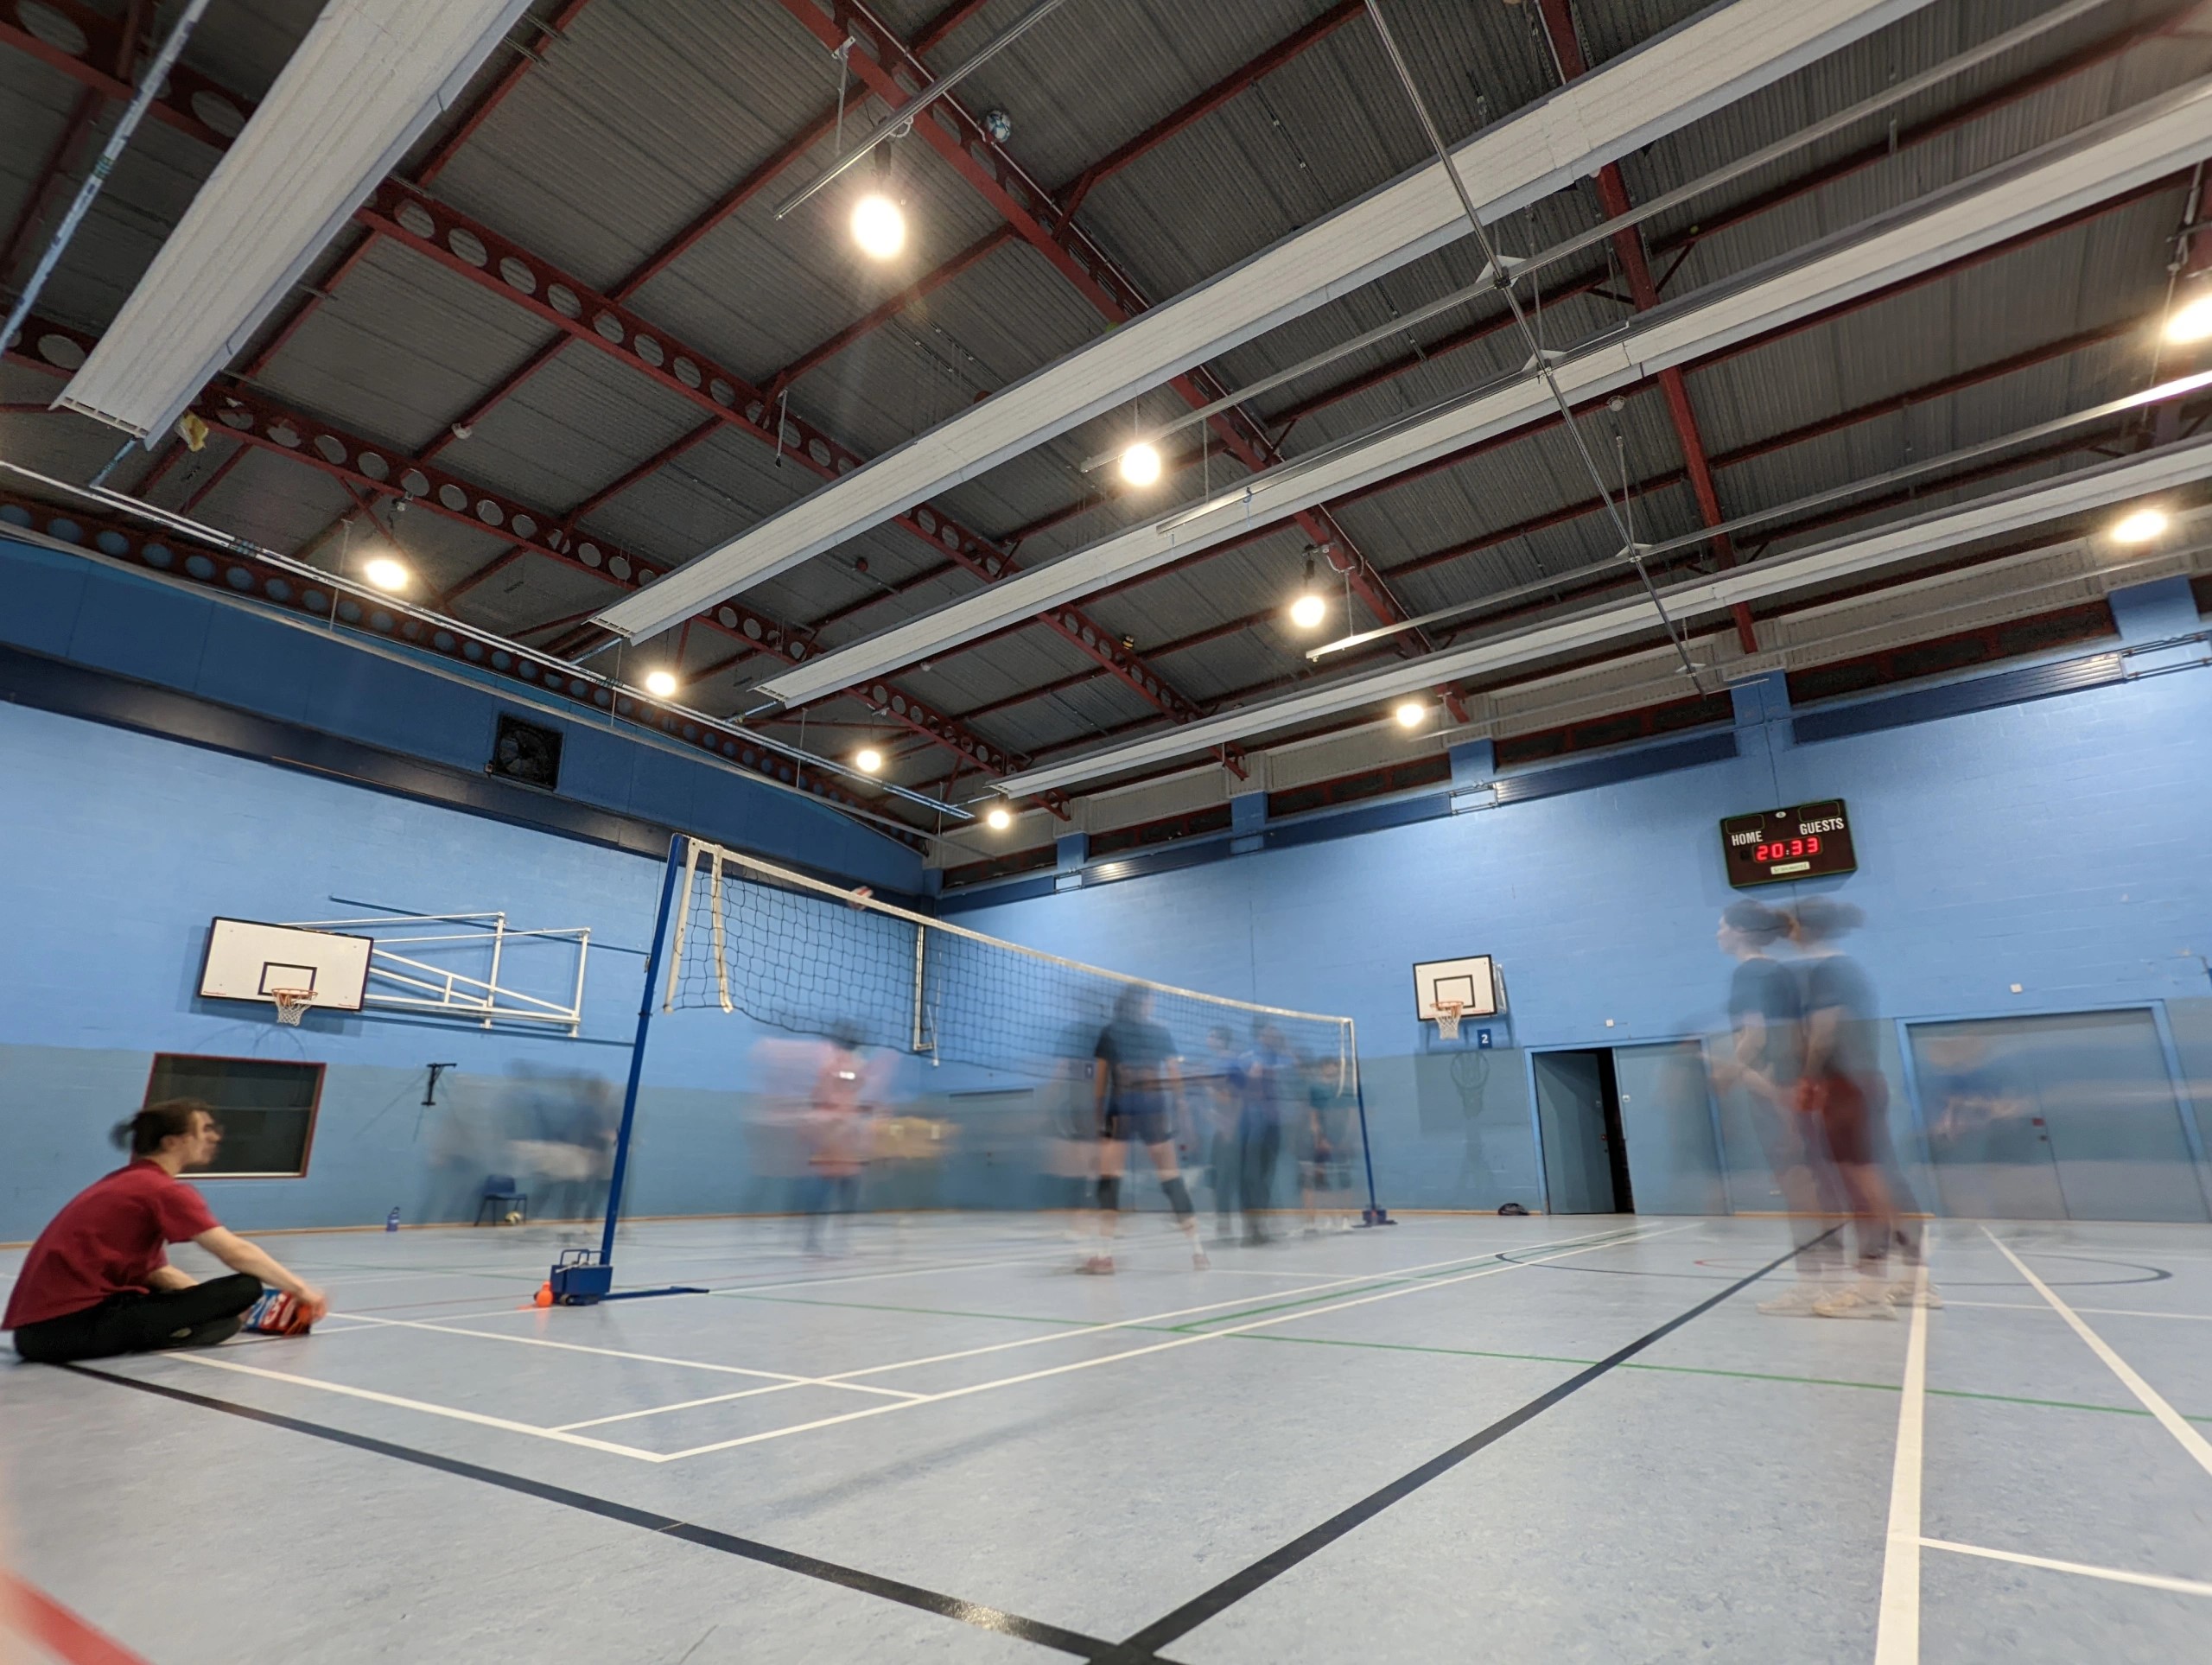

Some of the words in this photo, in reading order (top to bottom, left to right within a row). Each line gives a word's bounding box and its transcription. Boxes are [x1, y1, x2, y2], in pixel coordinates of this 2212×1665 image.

[1799, 817, 1844, 835] GUESTS
[1732, 830, 1763, 846] HOME
[1481, 1033, 1489, 1044] 2
